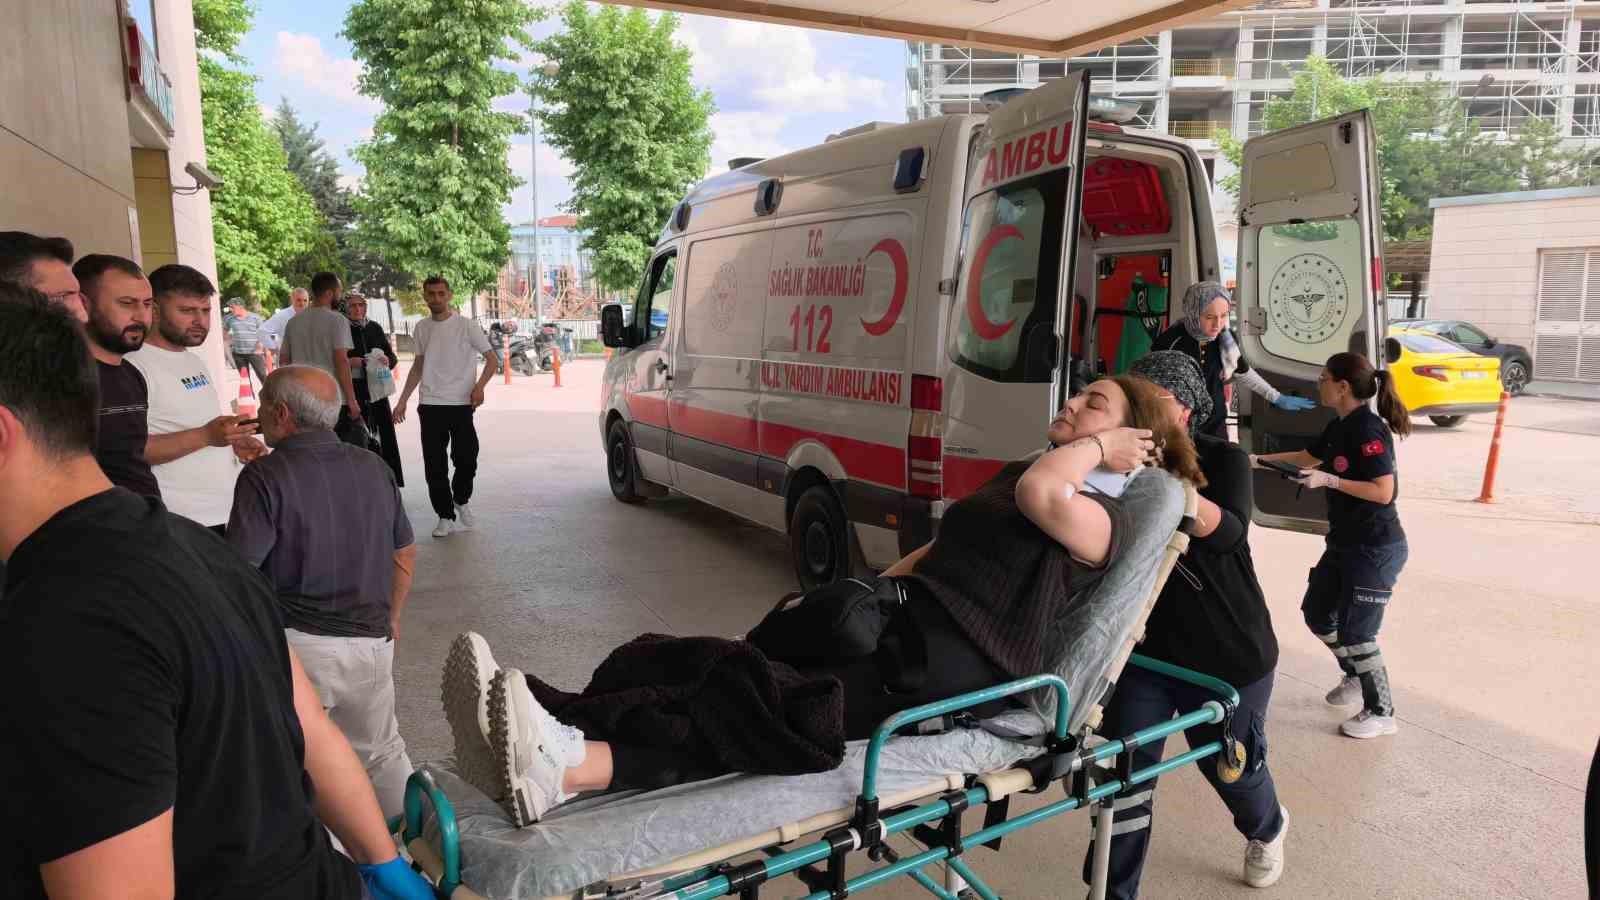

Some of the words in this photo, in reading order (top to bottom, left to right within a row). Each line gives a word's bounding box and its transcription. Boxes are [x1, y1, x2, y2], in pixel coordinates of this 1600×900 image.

[982, 121, 1073, 187] AMBU
[807, 228, 824, 257] T.C.
[769, 260, 803, 297] SAĞLIK
[806, 257, 867, 297] BAKANLIĞI
[789, 304, 833, 353] 112
[784, 363, 823, 392] YARDIM
[825, 366, 903, 404] AMBULANSI
